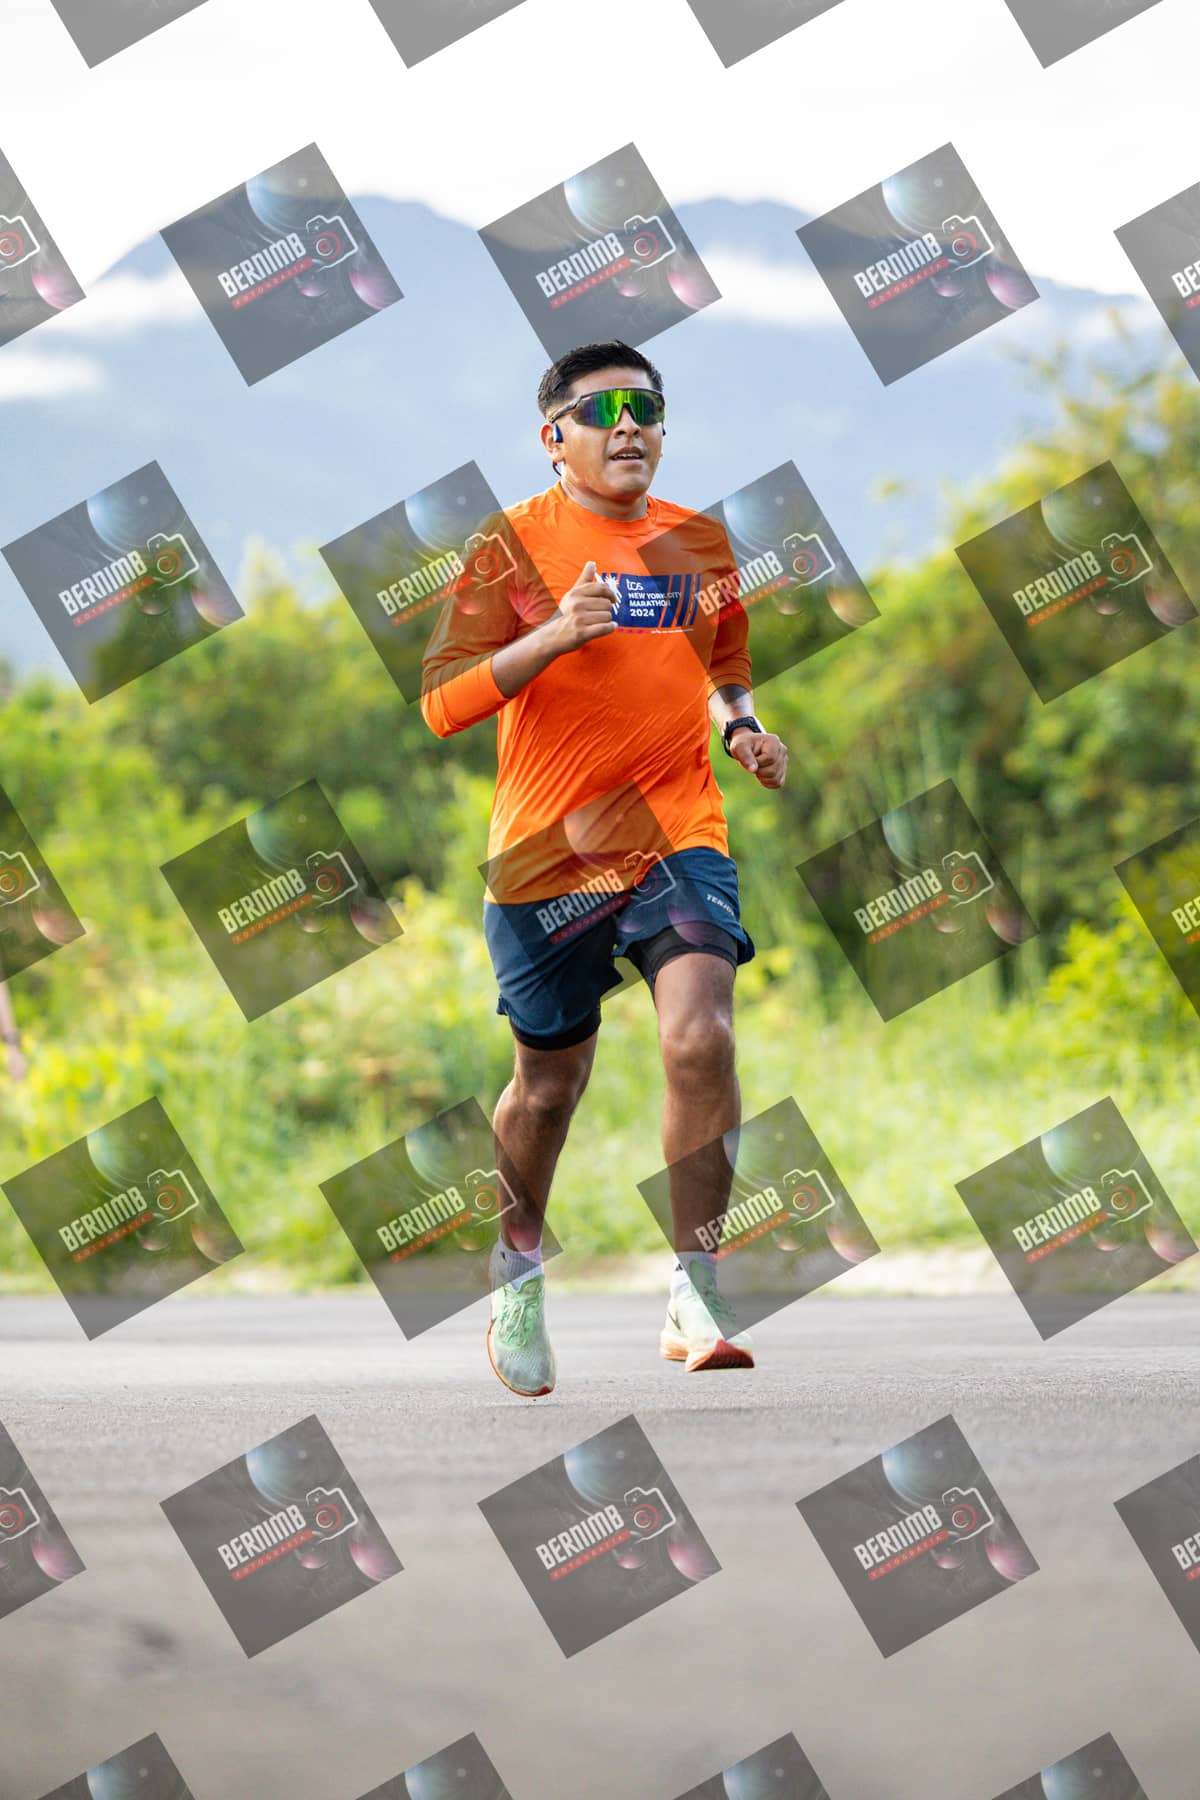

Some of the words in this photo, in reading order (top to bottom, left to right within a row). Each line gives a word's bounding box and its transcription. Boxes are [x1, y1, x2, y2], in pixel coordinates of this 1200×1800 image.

[646, 592, 665, 600] YORK
[666, 591, 682, 599] CITY
[630, 608, 655, 617] 2024
